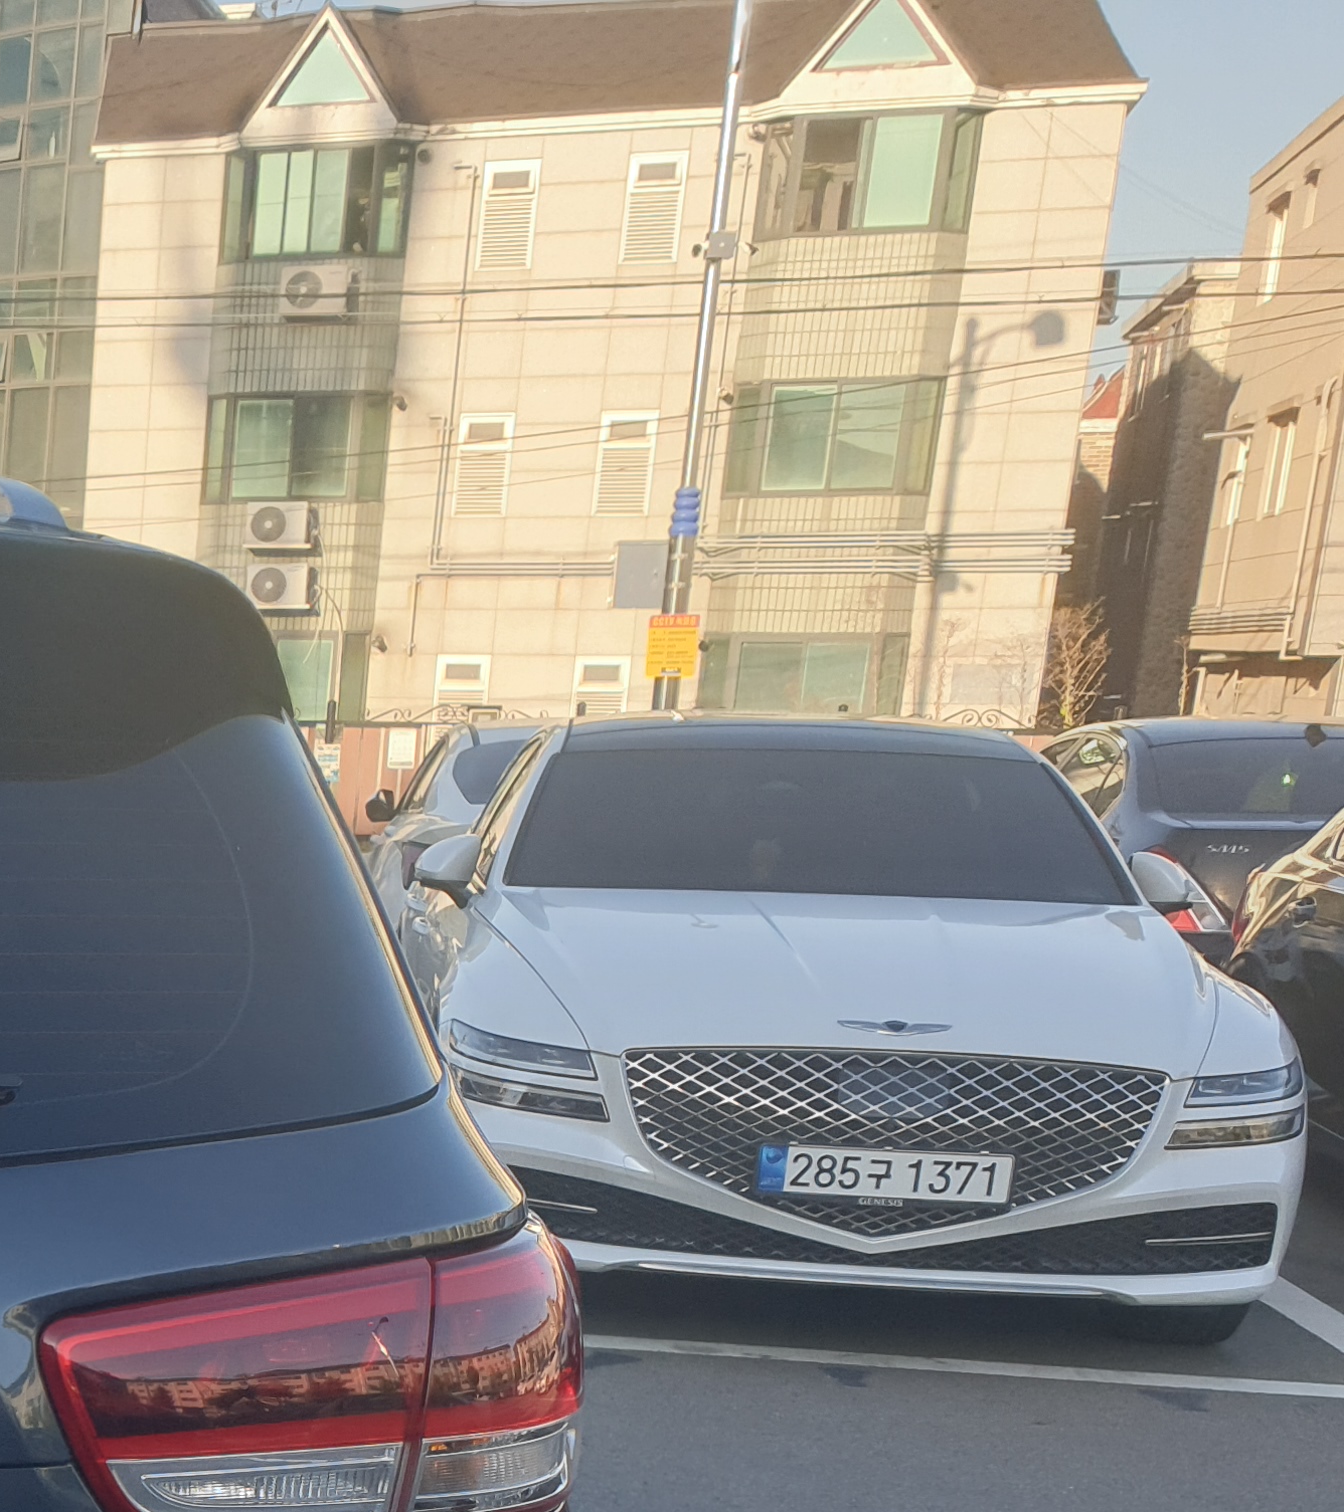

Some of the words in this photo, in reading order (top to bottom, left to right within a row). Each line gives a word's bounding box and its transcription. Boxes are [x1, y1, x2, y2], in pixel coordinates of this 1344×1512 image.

[789, 1152, 893, 1190] 285구
[908, 1158, 998, 1197] 1371
[858, 1197, 904, 1208] GENESIS
